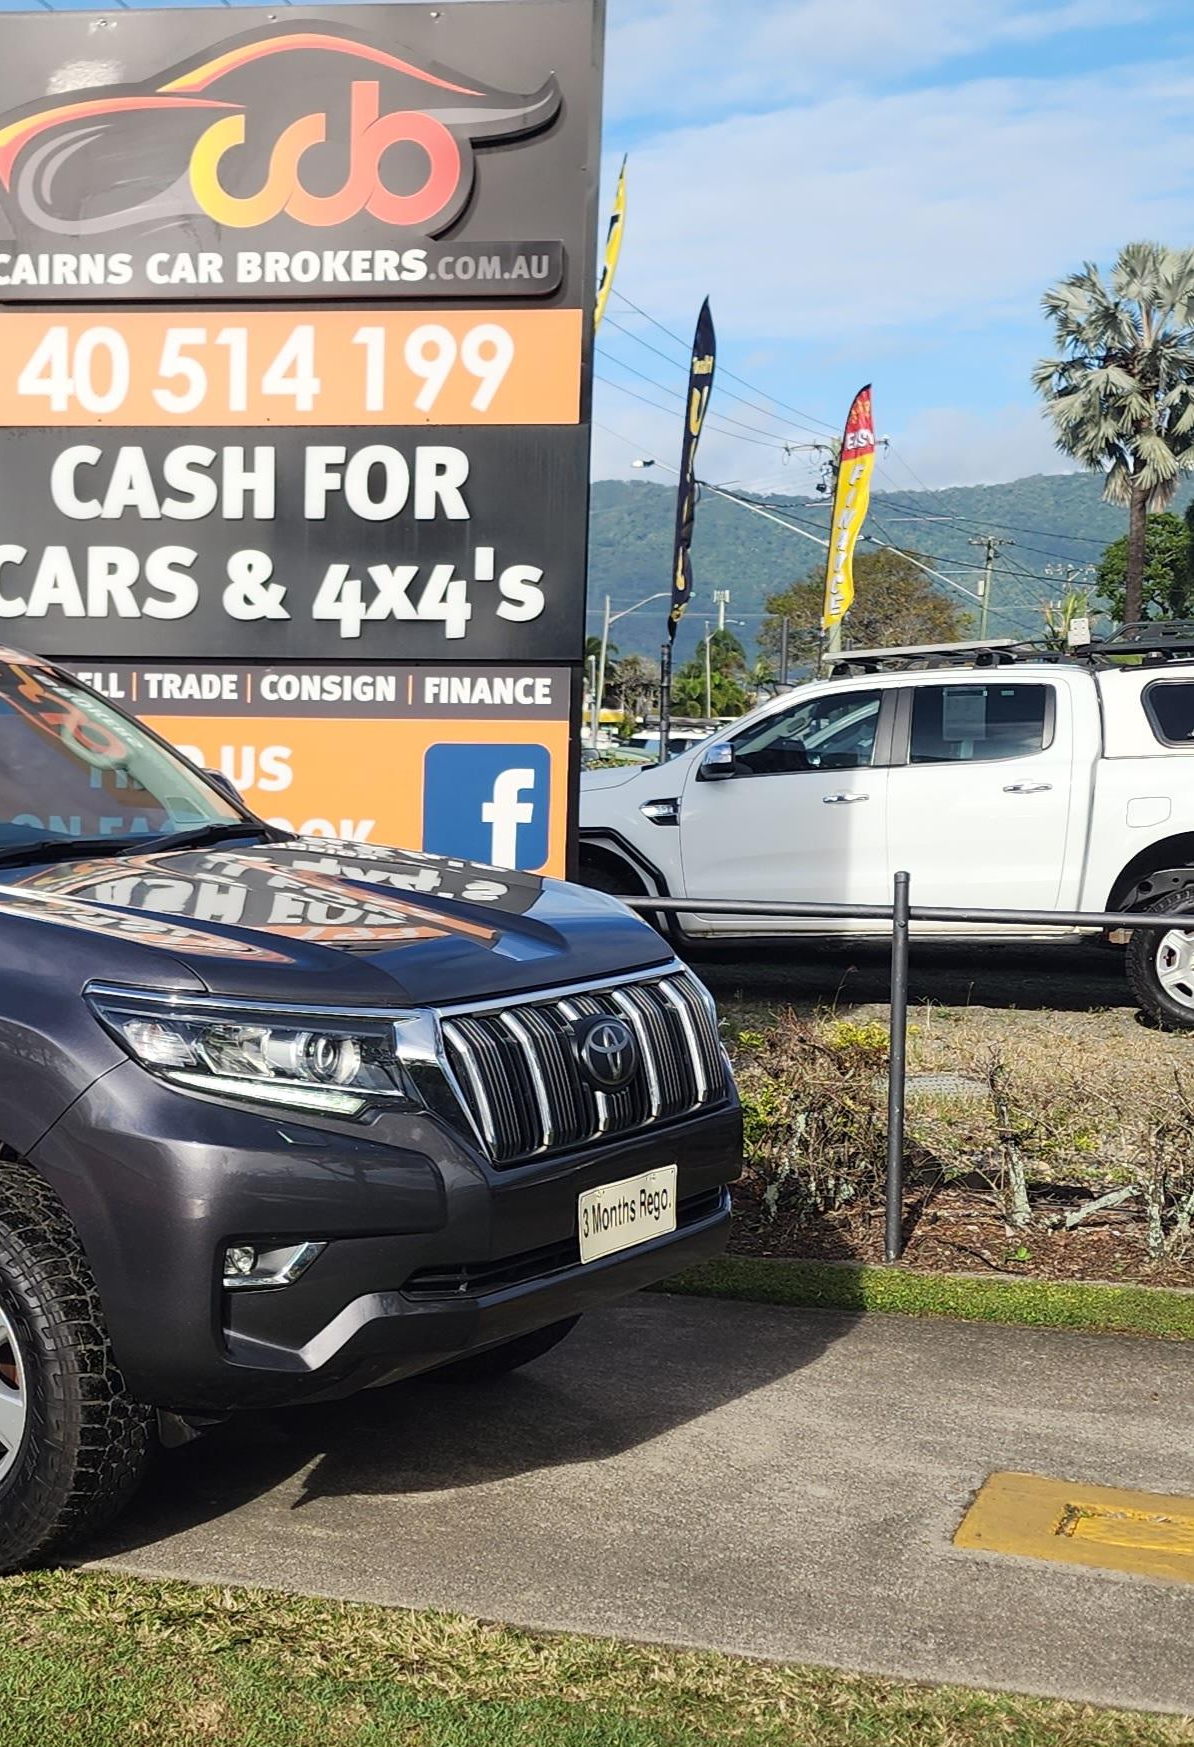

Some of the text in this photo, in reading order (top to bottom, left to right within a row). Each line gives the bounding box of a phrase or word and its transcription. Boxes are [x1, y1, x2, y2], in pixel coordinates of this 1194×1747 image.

[145, 252, 224, 284] CAR
[17, 323, 514, 413] 40 514 199
[50, 444, 471, 521] CASH FOR
[222, 549, 291, 621] &
[71, 672, 552, 705] ELL TRADE CONSIGN FINANCE
[220, 745, 293, 792] US
[582, 1188, 672, 1238] 3 Months Rego.
